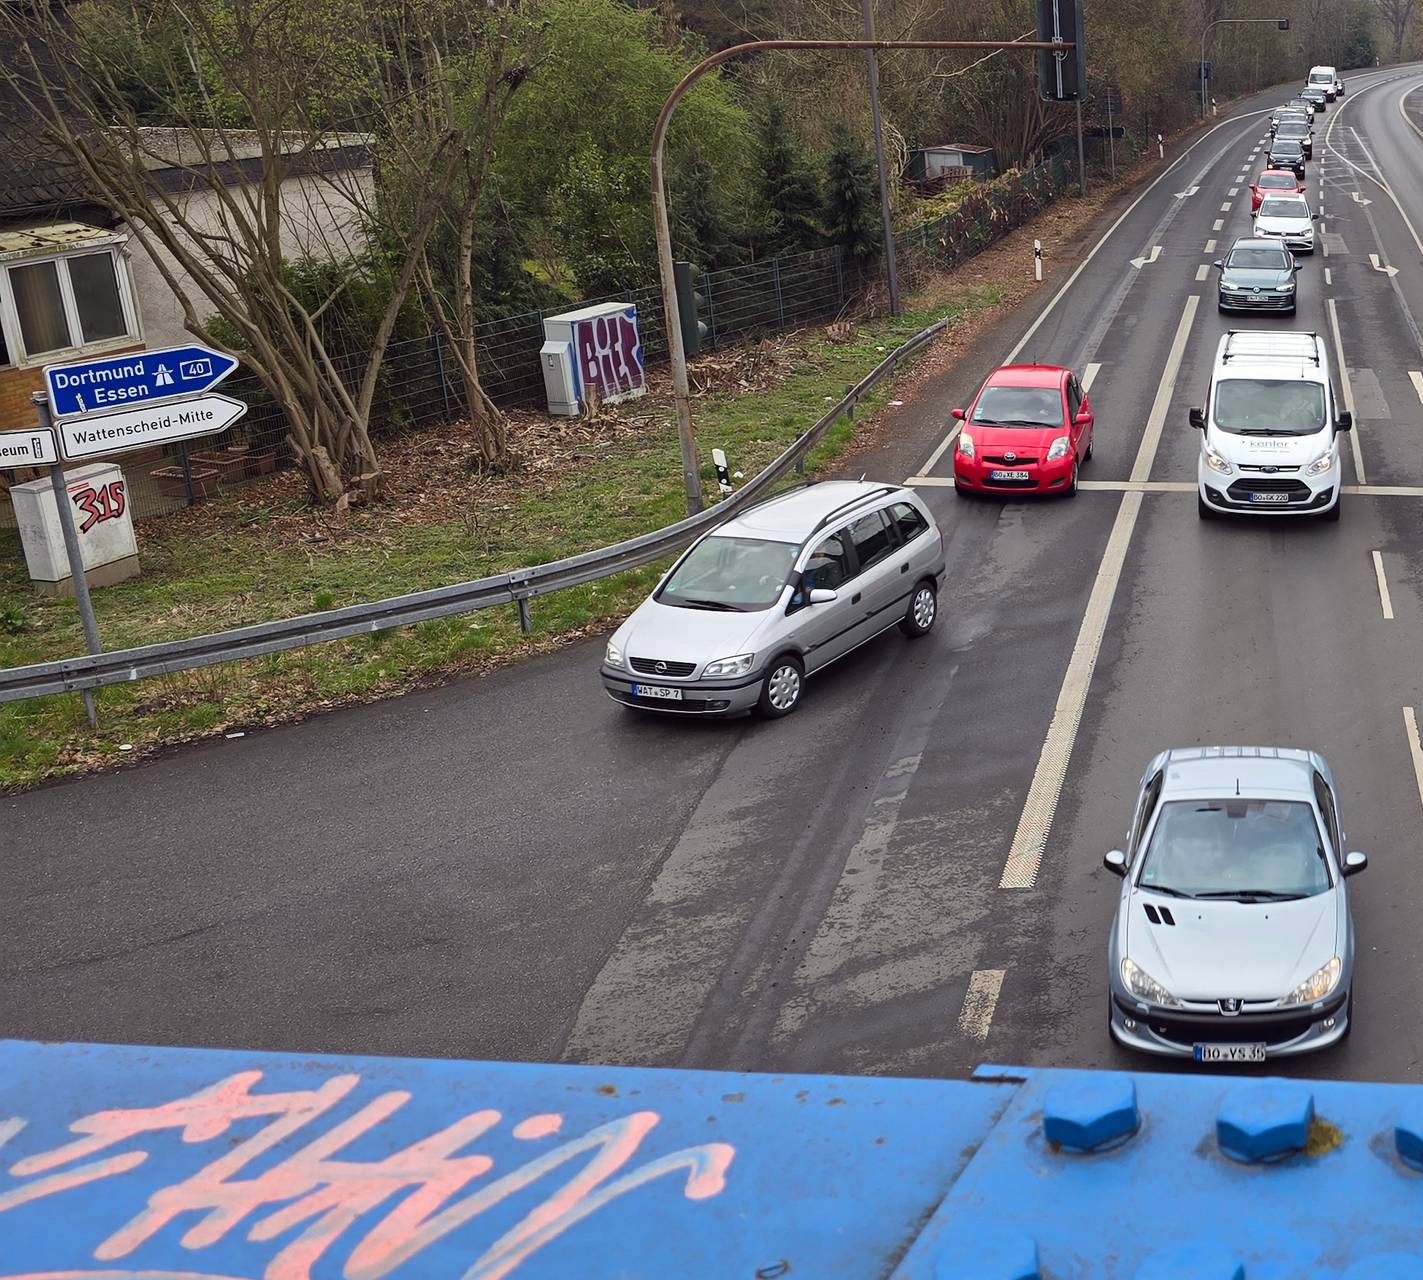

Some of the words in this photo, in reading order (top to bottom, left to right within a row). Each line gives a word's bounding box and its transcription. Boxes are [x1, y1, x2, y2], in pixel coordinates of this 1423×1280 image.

[55, 361, 145, 389] Dortmund
[188, 363, 204, 376] 40
[95, 383, 149, 404] Essen
[73, 409, 214, 445] Wattenscheid-Mitte
[0, 444, 29, 457] eum
[72, 480, 124, 534] 315
[637, 685, 653, 696] WAT
[660, 689, 671, 697] SP
